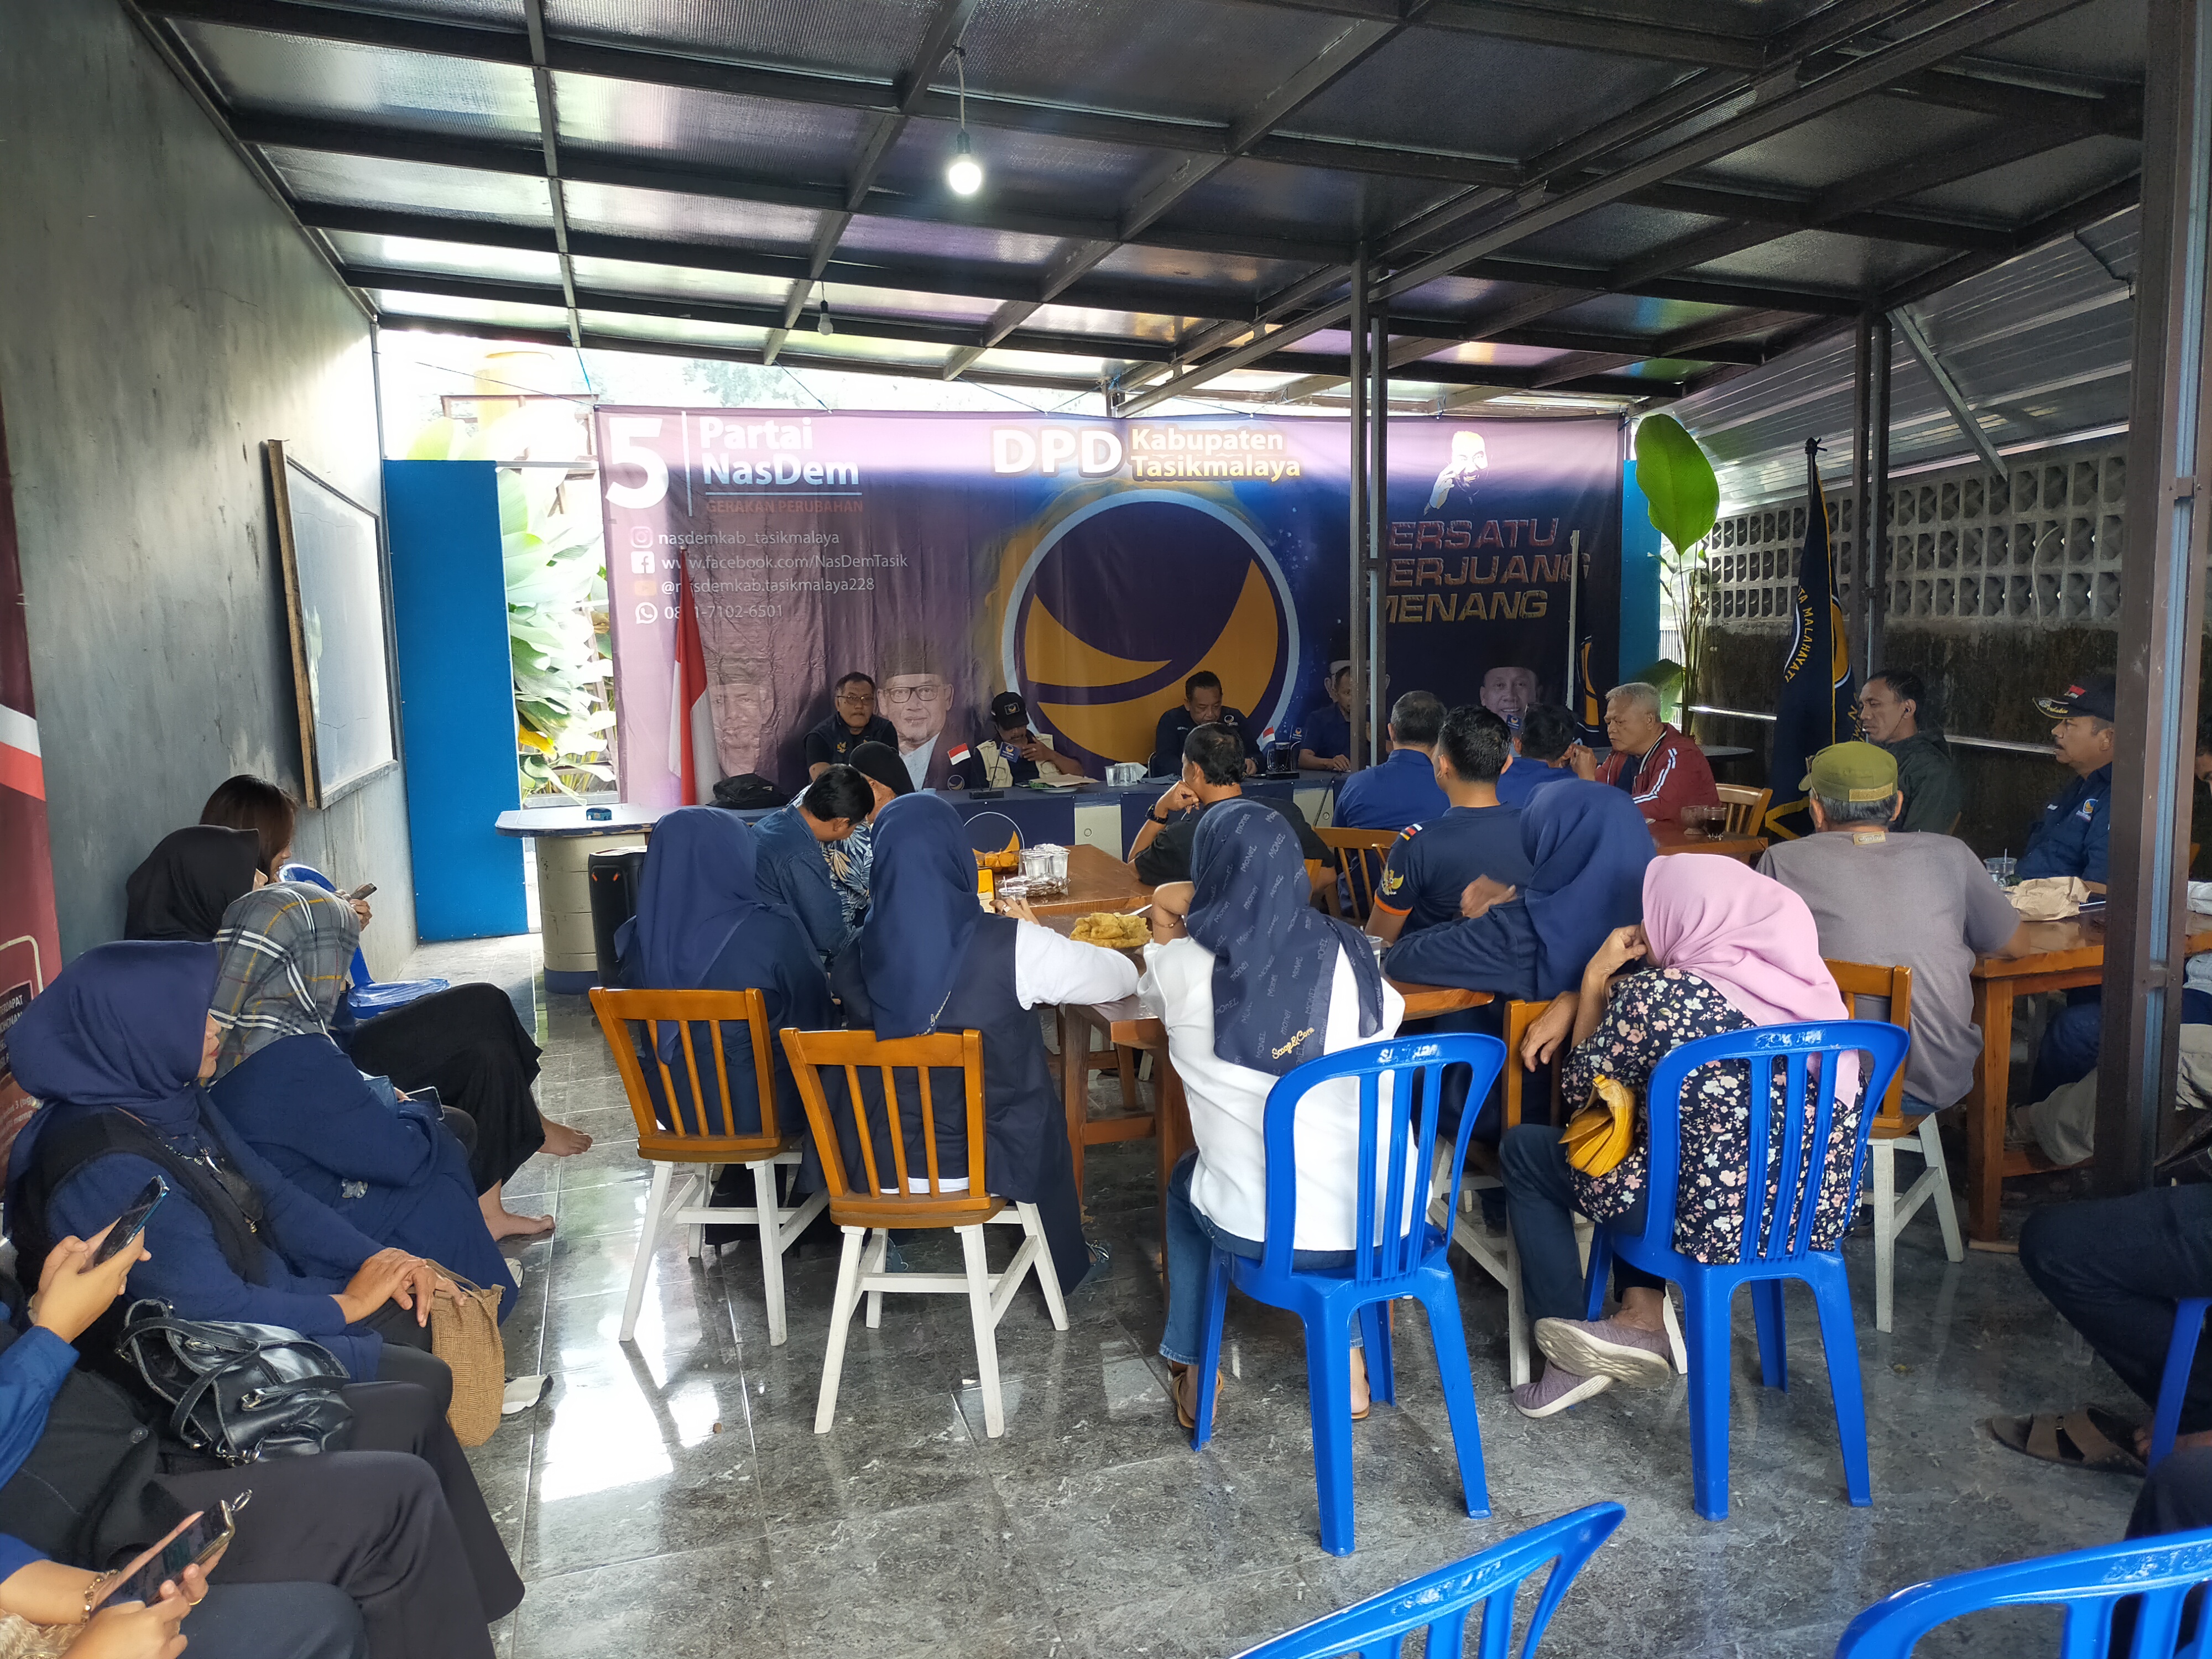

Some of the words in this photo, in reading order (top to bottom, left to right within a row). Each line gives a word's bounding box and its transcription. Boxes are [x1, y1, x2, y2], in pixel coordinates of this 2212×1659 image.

[700, 416, 813, 450] Partai
[1131, 427, 1284, 457] Kabupaten
[605, 417, 669, 509] 5
[993, 429, 1123, 474] DPD
[703, 453, 859, 486] NasDem
[1131, 455, 1301, 482] Tasikmalaya
[706, 499, 773, 513] GERAKAN
[778, 499, 863, 513] PERUBAHAN
[658, 530, 839, 547] nasdemkab_tasikmalaya
[1386, 518, 1558, 551] ERSATU
[1386, 552, 1590, 587] ERJUANG
[661, 578, 875, 594] @nsdemkab.tasikmalaya228
[664, 604, 783, 619] 081-7102-6501
[1784, 607, 1814, 683] MALAHAYATI
[1268, 833, 1285, 858] MONEL
